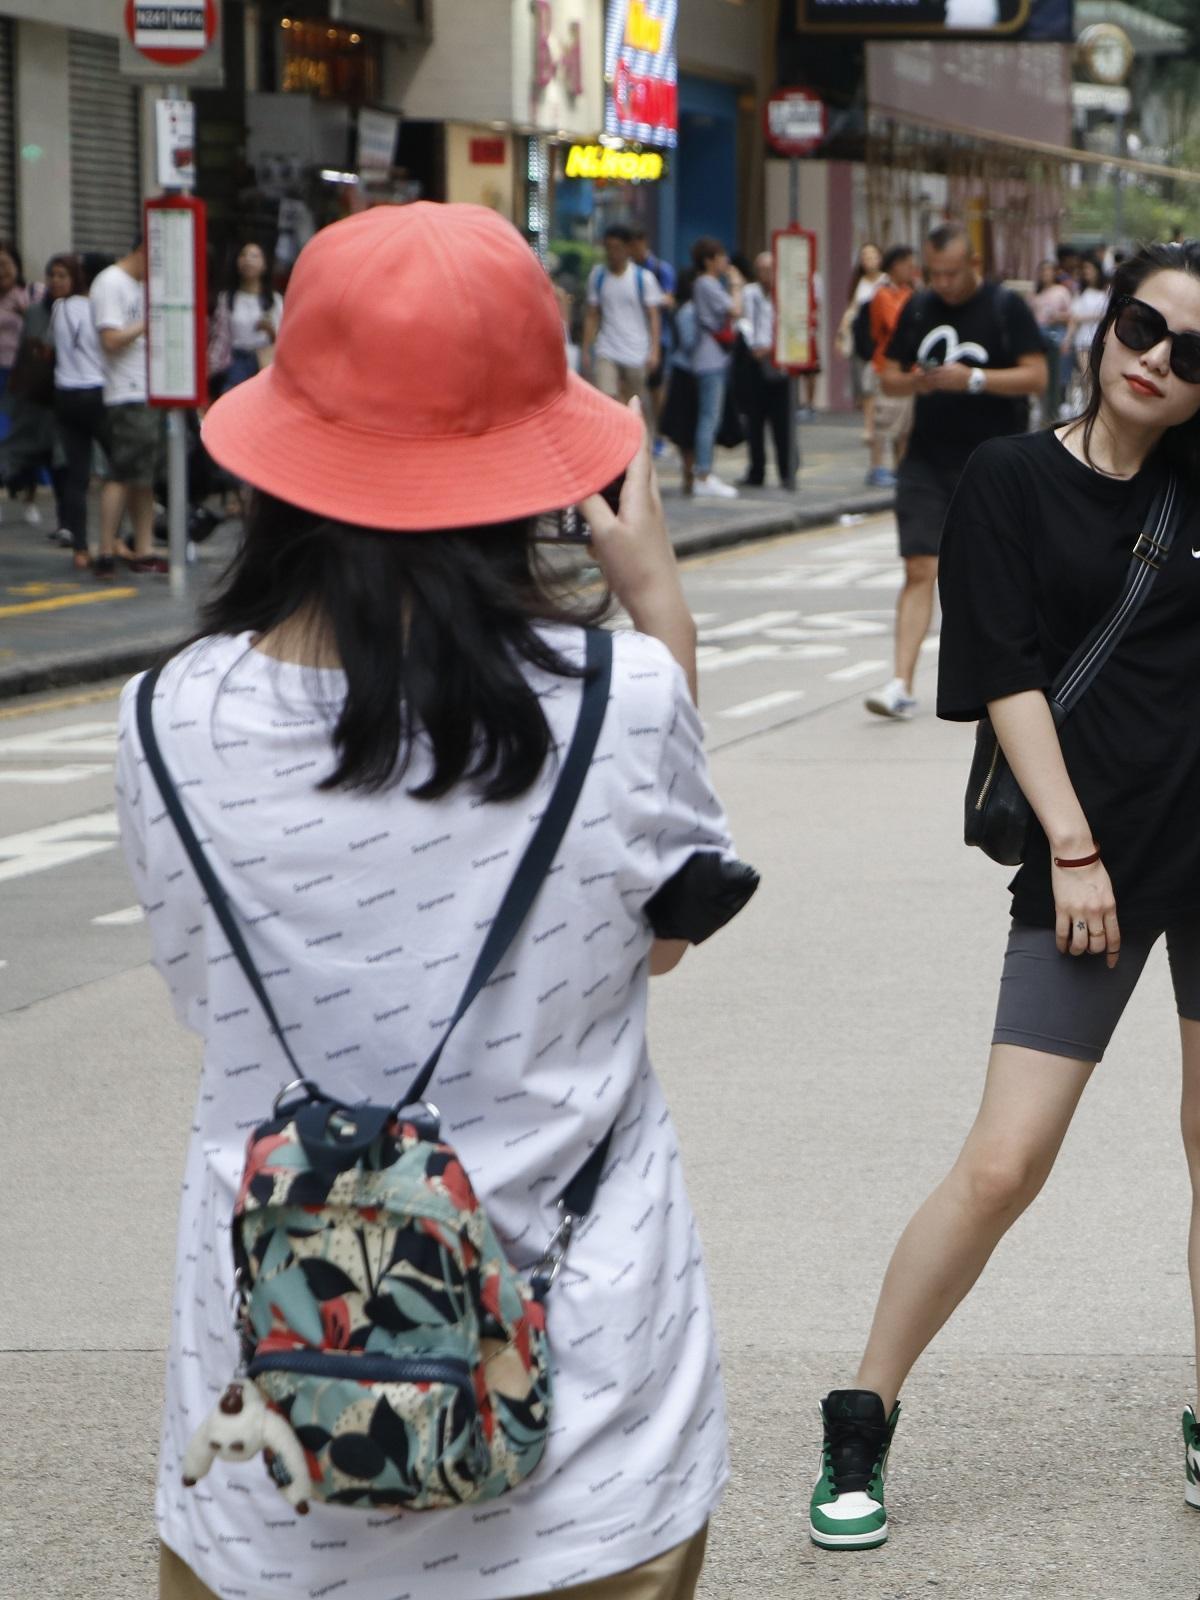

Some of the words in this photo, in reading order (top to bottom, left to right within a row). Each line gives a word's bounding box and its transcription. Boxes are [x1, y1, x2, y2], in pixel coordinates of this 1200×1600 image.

[566, 145, 663, 179] Nikon
[274, 760, 316, 777] Supreme
[219, 797, 258, 810] Supreme
[282, 817, 324, 836] Supreme
[348, 831, 390, 851] Supreme
[411, 834, 451, 854] Supreme
[471, 849, 509, 869] Supreme
[293, 874, 333, 893] Supreme
[357, 888, 396, 908] Supreme
[416, 893, 455, 912] Supreme
[305, 931, 343, 948] Supreme
[365, 946, 403, 963] Supreme
[423, 952, 460, 971] Supreme
[314, 988, 352, 1005] Supreme
[214, 1008, 250, 1022] Supreme
[373, 1004, 410, 1024] Supreme
[485, 1032, 522, 1050] Supreme
[325, 1044, 360, 1061] Supreme
